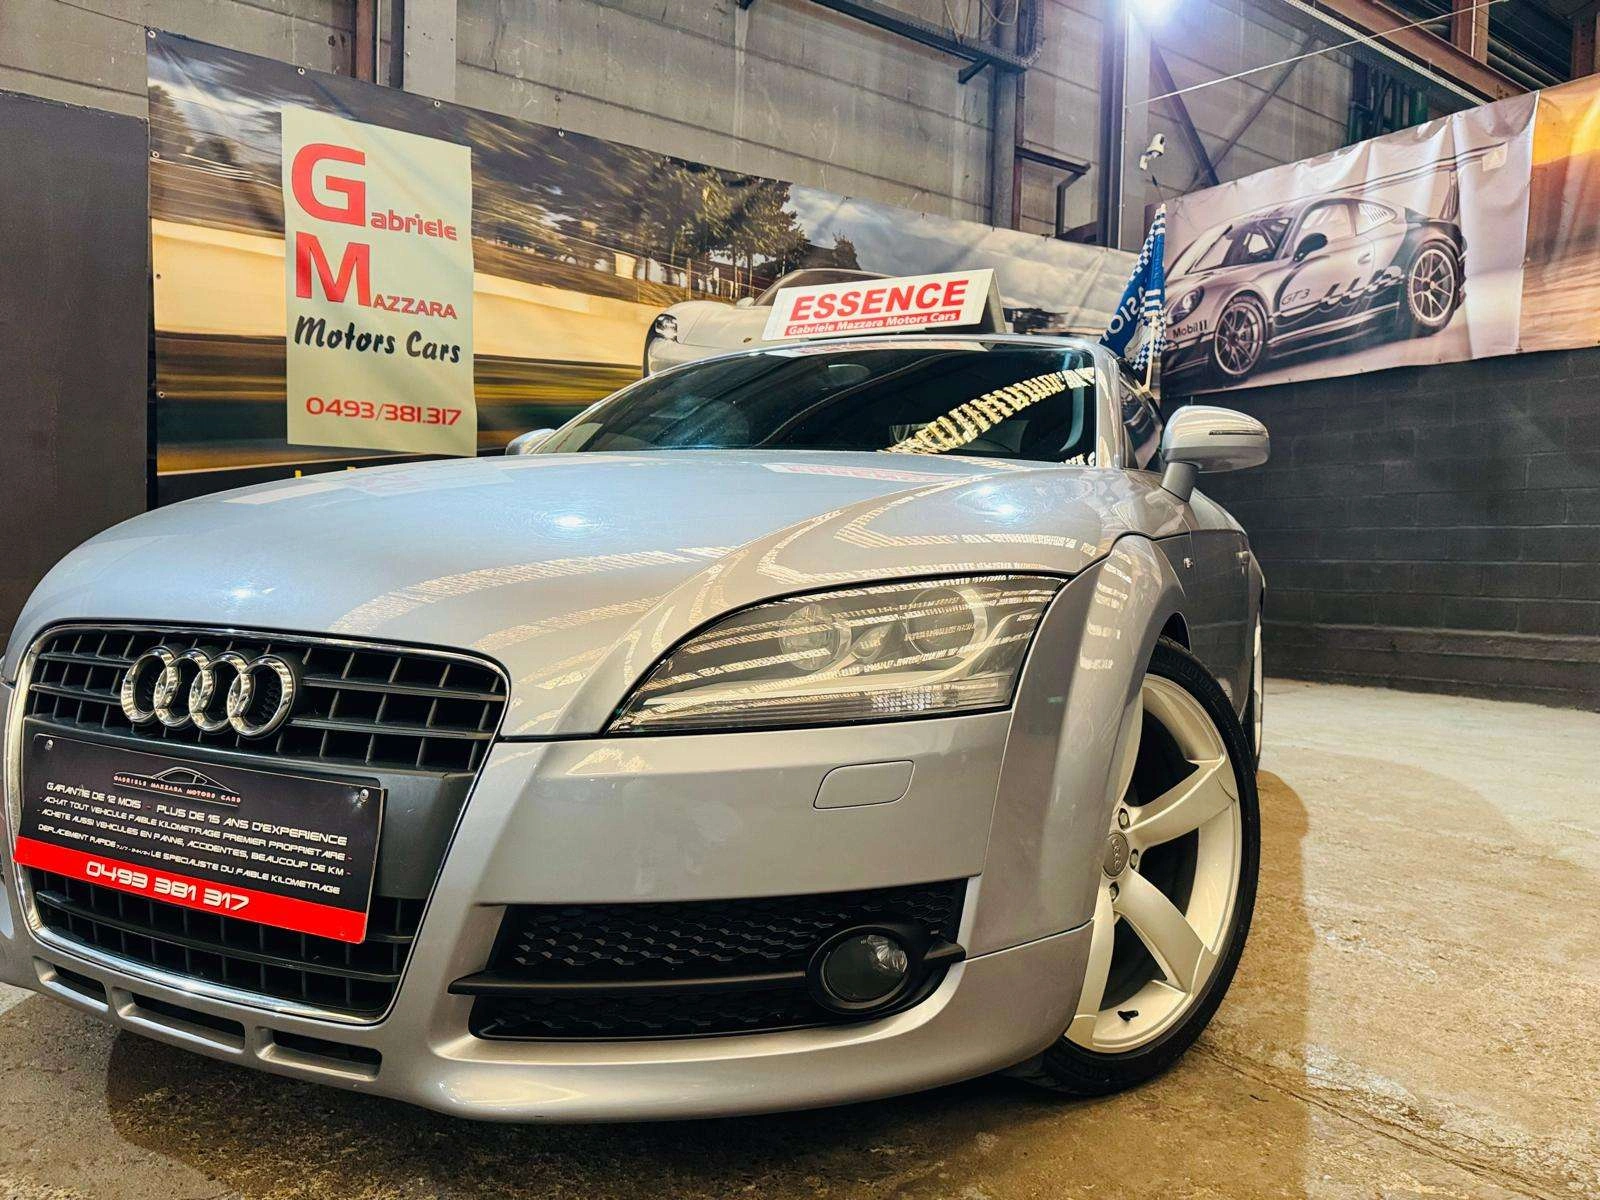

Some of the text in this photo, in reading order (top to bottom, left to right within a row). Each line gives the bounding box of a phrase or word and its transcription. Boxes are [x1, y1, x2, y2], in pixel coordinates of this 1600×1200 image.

[788, 311, 957, 336] Gabriele Mazzara Motors Cars
[789, 280, 970, 322] ESSENCE
[294, 315, 461, 364] Motors Cars
[1172, 322, 1198, 339] Mobil
[305, 396, 462, 426] 0493/381.317
[43, 796, 69, 807] ACHAT
[69, 800, 90, 812] TOUT
[90, 805, 128, 820] VEHICULE
[128, 813, 158, 826] FAIBLE
[158, 820, 221, 839] KILOMETRAGE
[222, 832, 267, 847] PREMIER
[46, 782, 91, 799] GARANTIE
[91, 791, 106, 802] DE
[107, 794, 117, 804] 12
[117, 797, 142, 809] MOIS
[156, 804, 187, 818] PLUS
[188, 810, 205, 822] DE
[207, 814, 221, 825] 15
[223, 817, 249, 830] ANS
[251, 821, 348, 847] D'EXPERIENCE
[37, 823, 90, 841] DEPLACEMENT
[89, 835, 117, 848] RAPIDE
[151, 850, 161, 859] LE
[162, 852, 219, 871] SPECIALISTE
[220, 864, 235, 874] DU
[271, 874, 341, 895] KILOMETRAGE
[41, 808, 72, 821] ACHETE
[72, 815, 95, 826] AUSSI
[95, 819, 139, 836] VEHICULES
[139, 829, 153, 839] EN
[186, 840, 249, 860] ACCIDENTES,
[250, 851, 309, 869] BEAUCOUP
[310, 862, 327, 873] DE
[327, 865, 345, 877] KM
[85, 860, 250, 911] 0493 381 317
